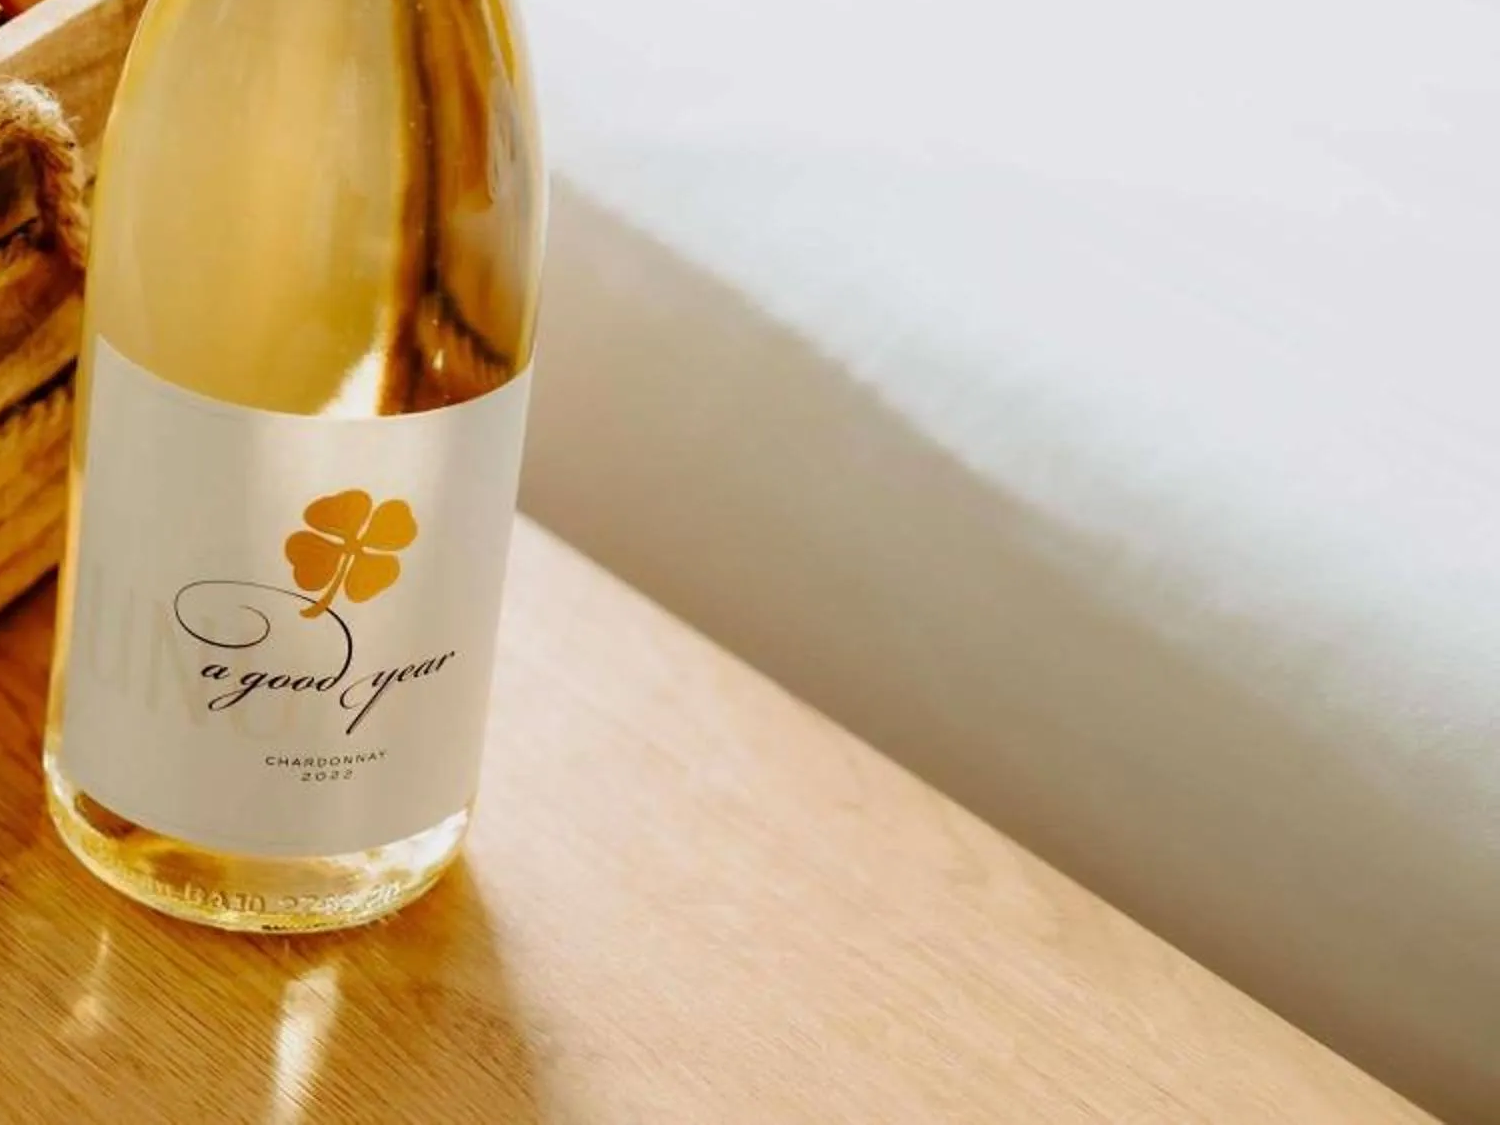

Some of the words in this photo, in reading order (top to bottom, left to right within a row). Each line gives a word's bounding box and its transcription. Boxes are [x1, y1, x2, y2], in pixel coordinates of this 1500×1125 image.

[200, 663, 229, 680] a
[339, 651, 456, 735] year
[264, 750, 388, 768] CHARDONNAY
[300, 769, 354, 782] 2022
